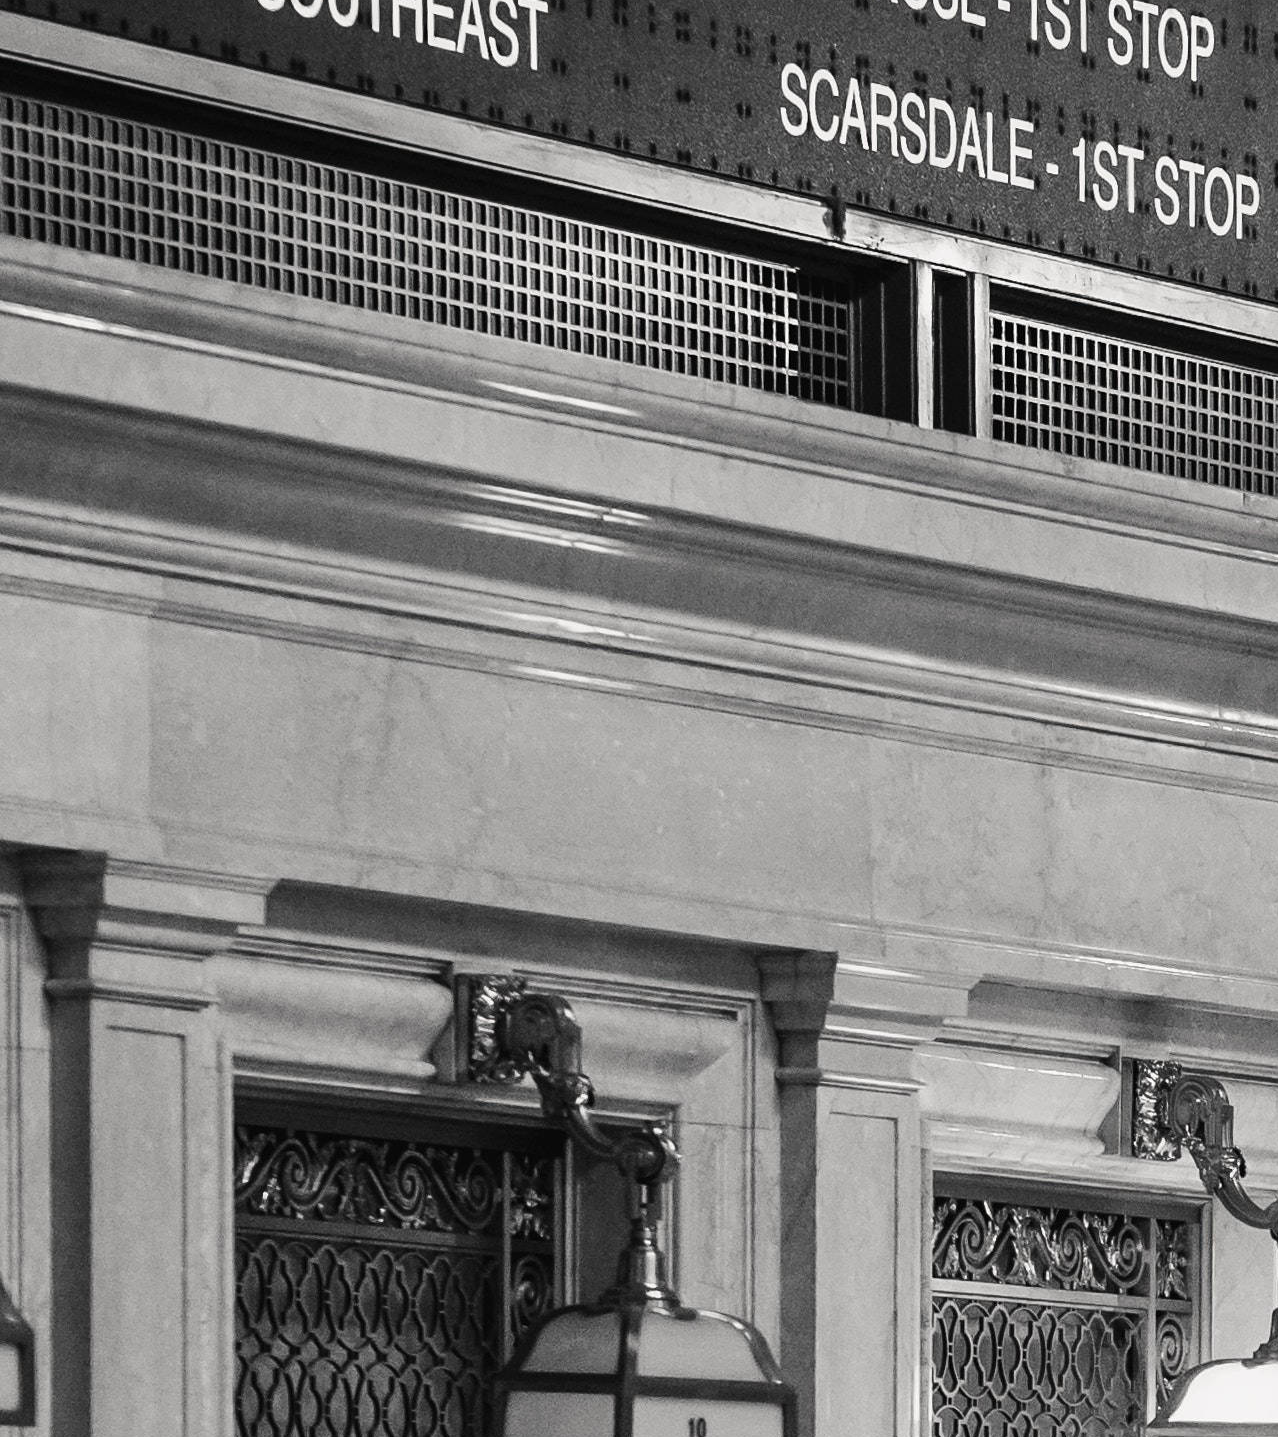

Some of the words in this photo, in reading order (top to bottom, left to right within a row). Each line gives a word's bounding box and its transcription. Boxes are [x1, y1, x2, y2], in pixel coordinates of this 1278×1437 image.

[998, 0, 1010, 11] -
[781, 63, 1034, 189] SCARSDALE
[1046, 163, 1058, 174] -
[1073, 138, 1144, 213] 1ST
[1154, 156, 1259, 239] STOP
